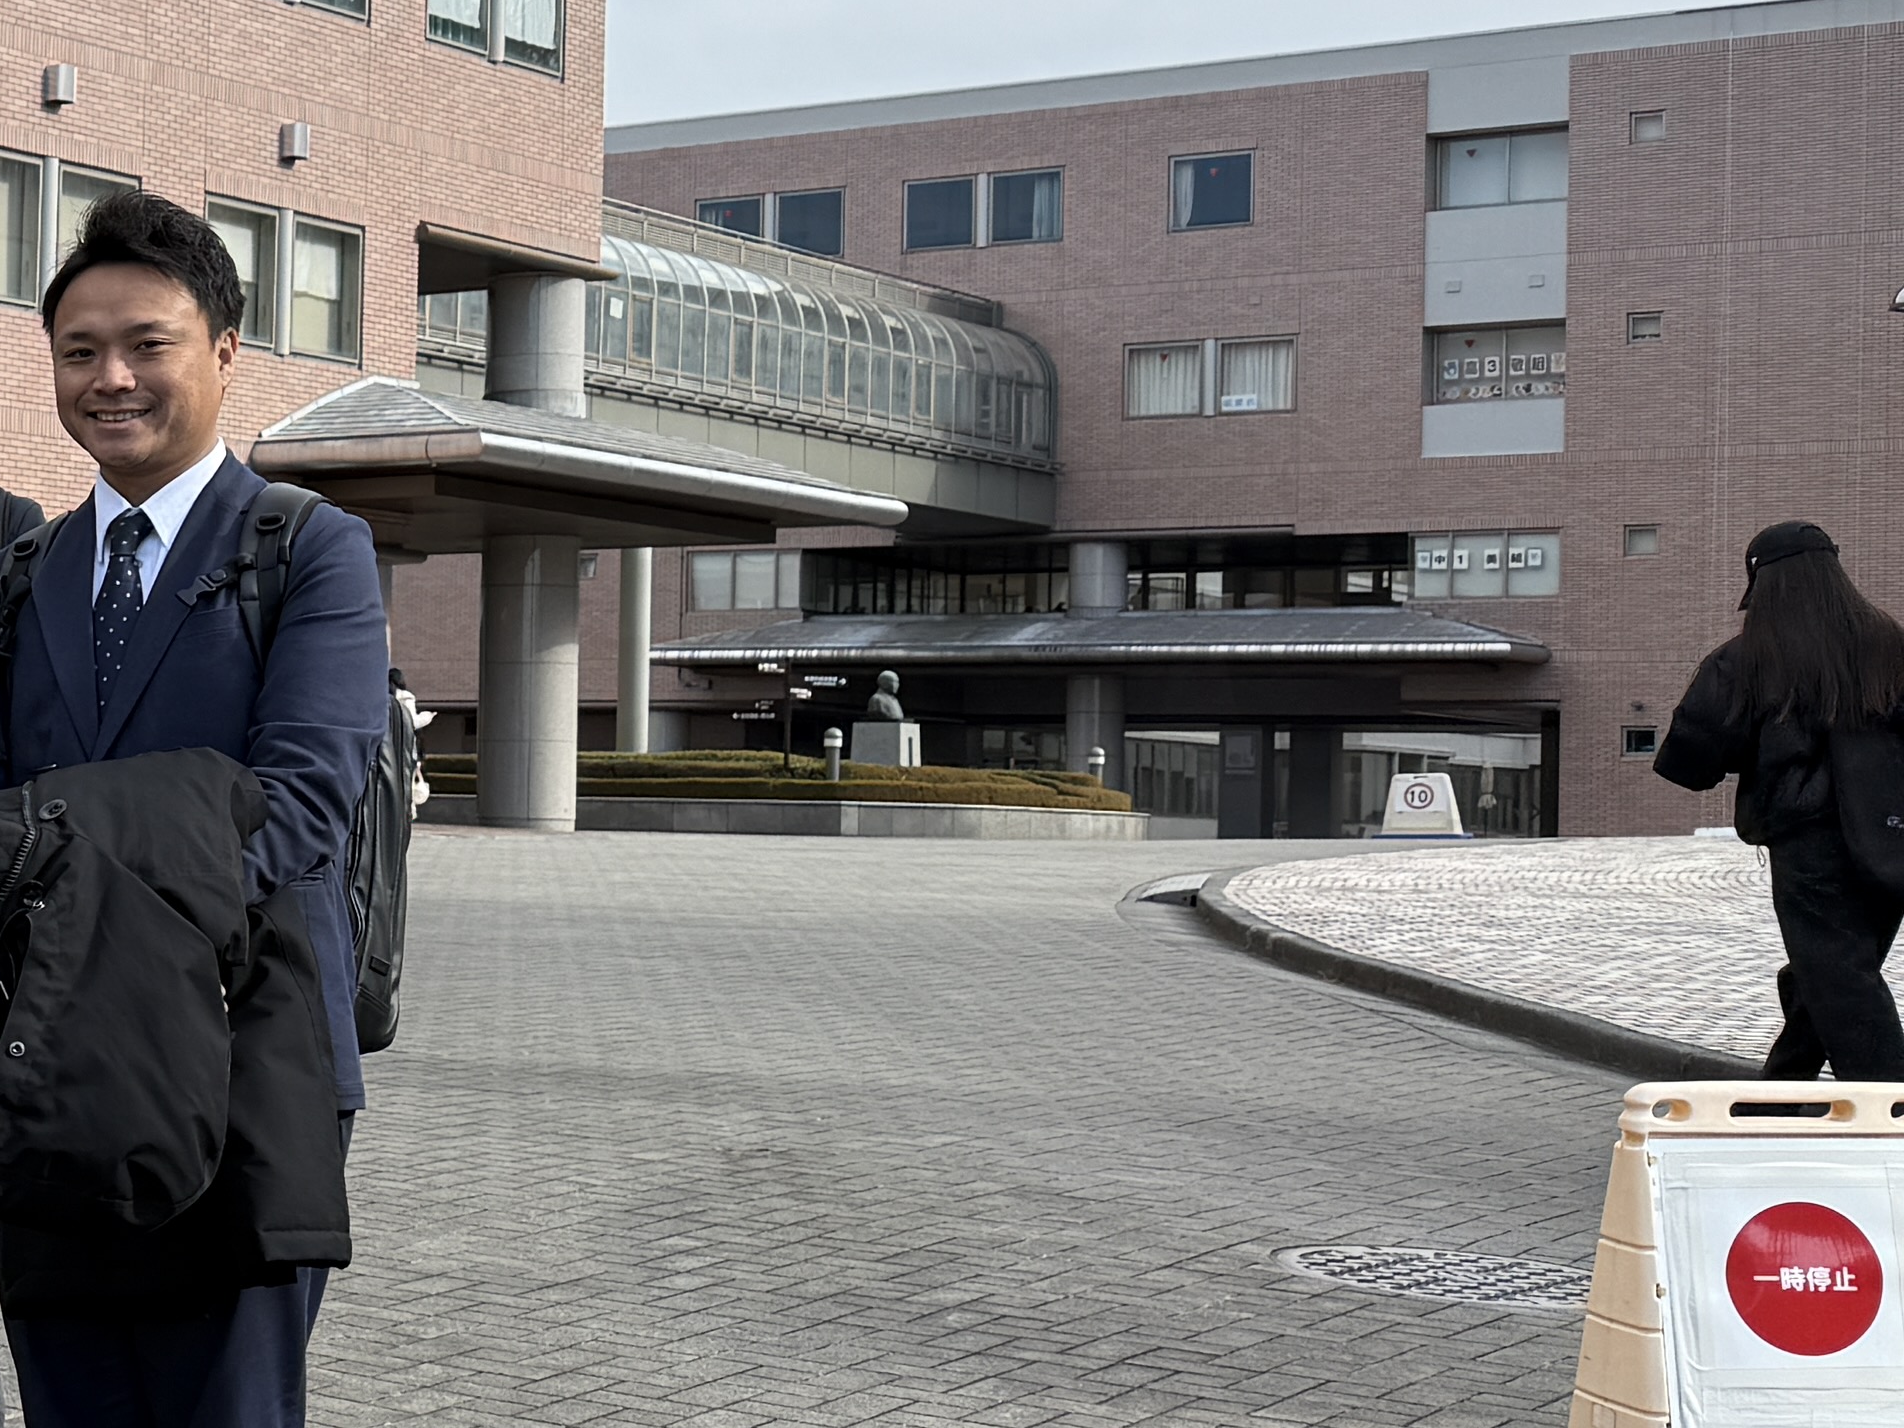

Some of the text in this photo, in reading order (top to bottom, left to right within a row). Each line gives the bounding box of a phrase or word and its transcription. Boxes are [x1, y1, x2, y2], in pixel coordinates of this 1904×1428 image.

[1410, 789, 1428, 804] 10
[1753, 1266, 1859, 1292] 一時停止
